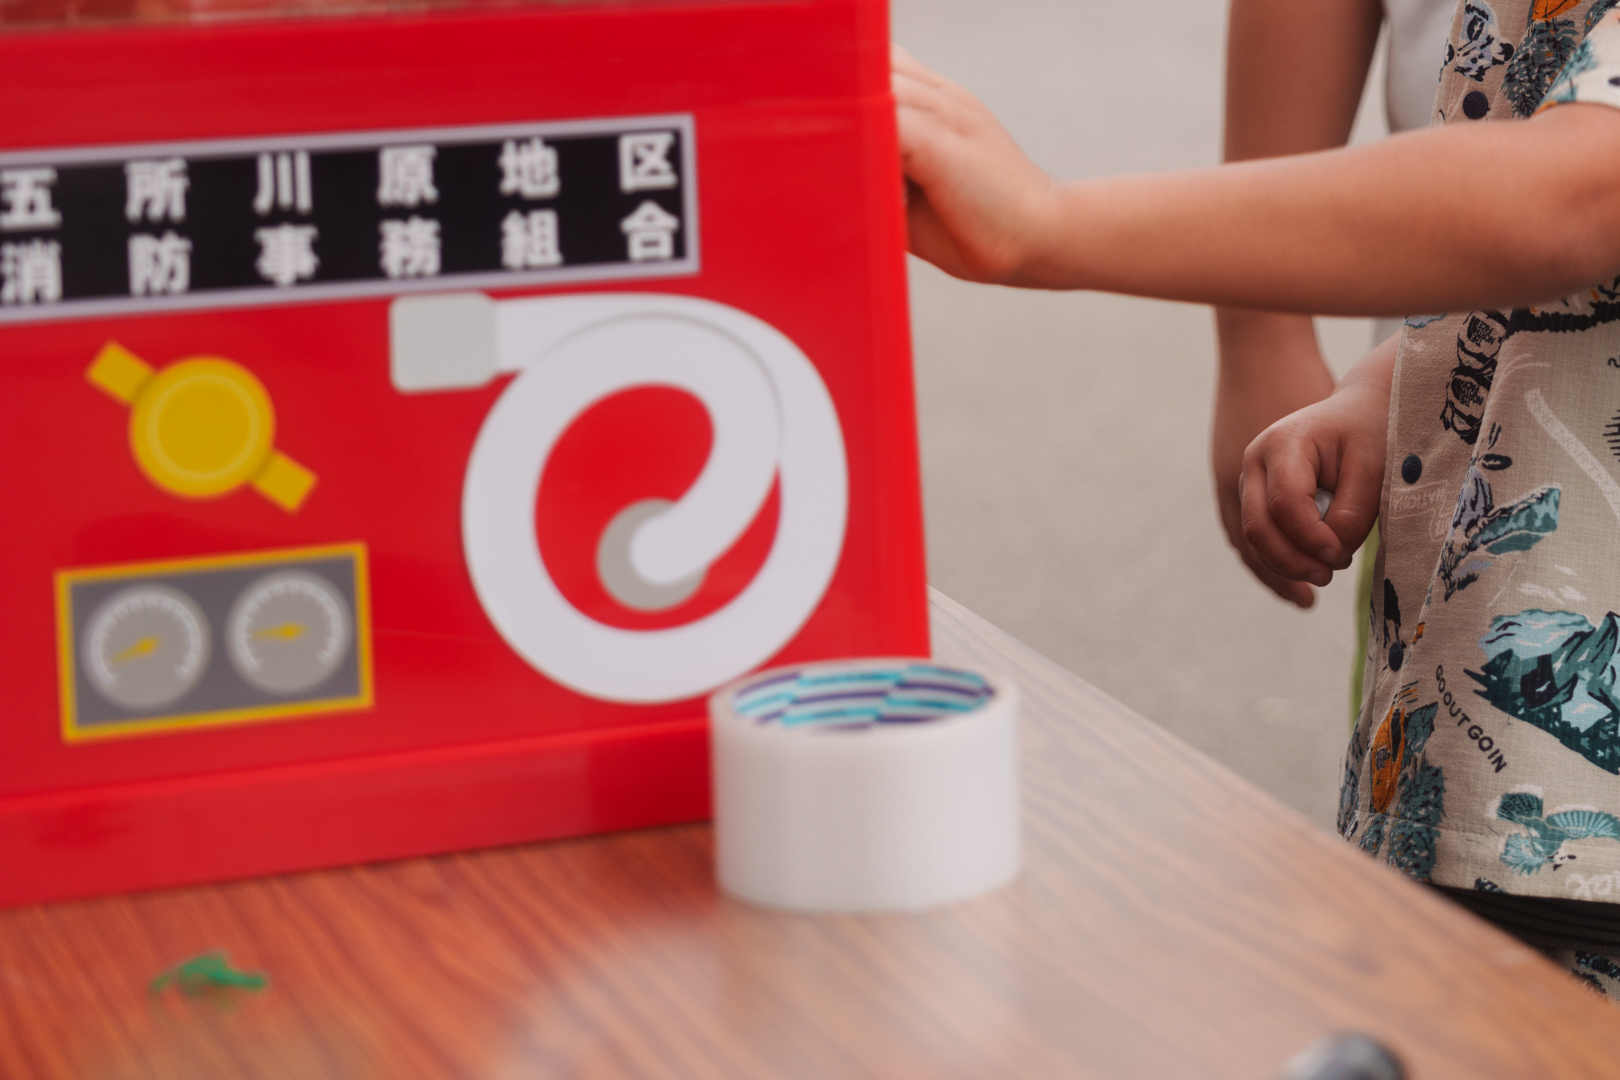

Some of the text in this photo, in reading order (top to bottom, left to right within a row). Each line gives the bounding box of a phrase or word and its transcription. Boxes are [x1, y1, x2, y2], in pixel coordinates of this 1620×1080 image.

[0, 131, 678, 229] 五所川原地区
[0, 202, 680, 304] 消防事務組合
